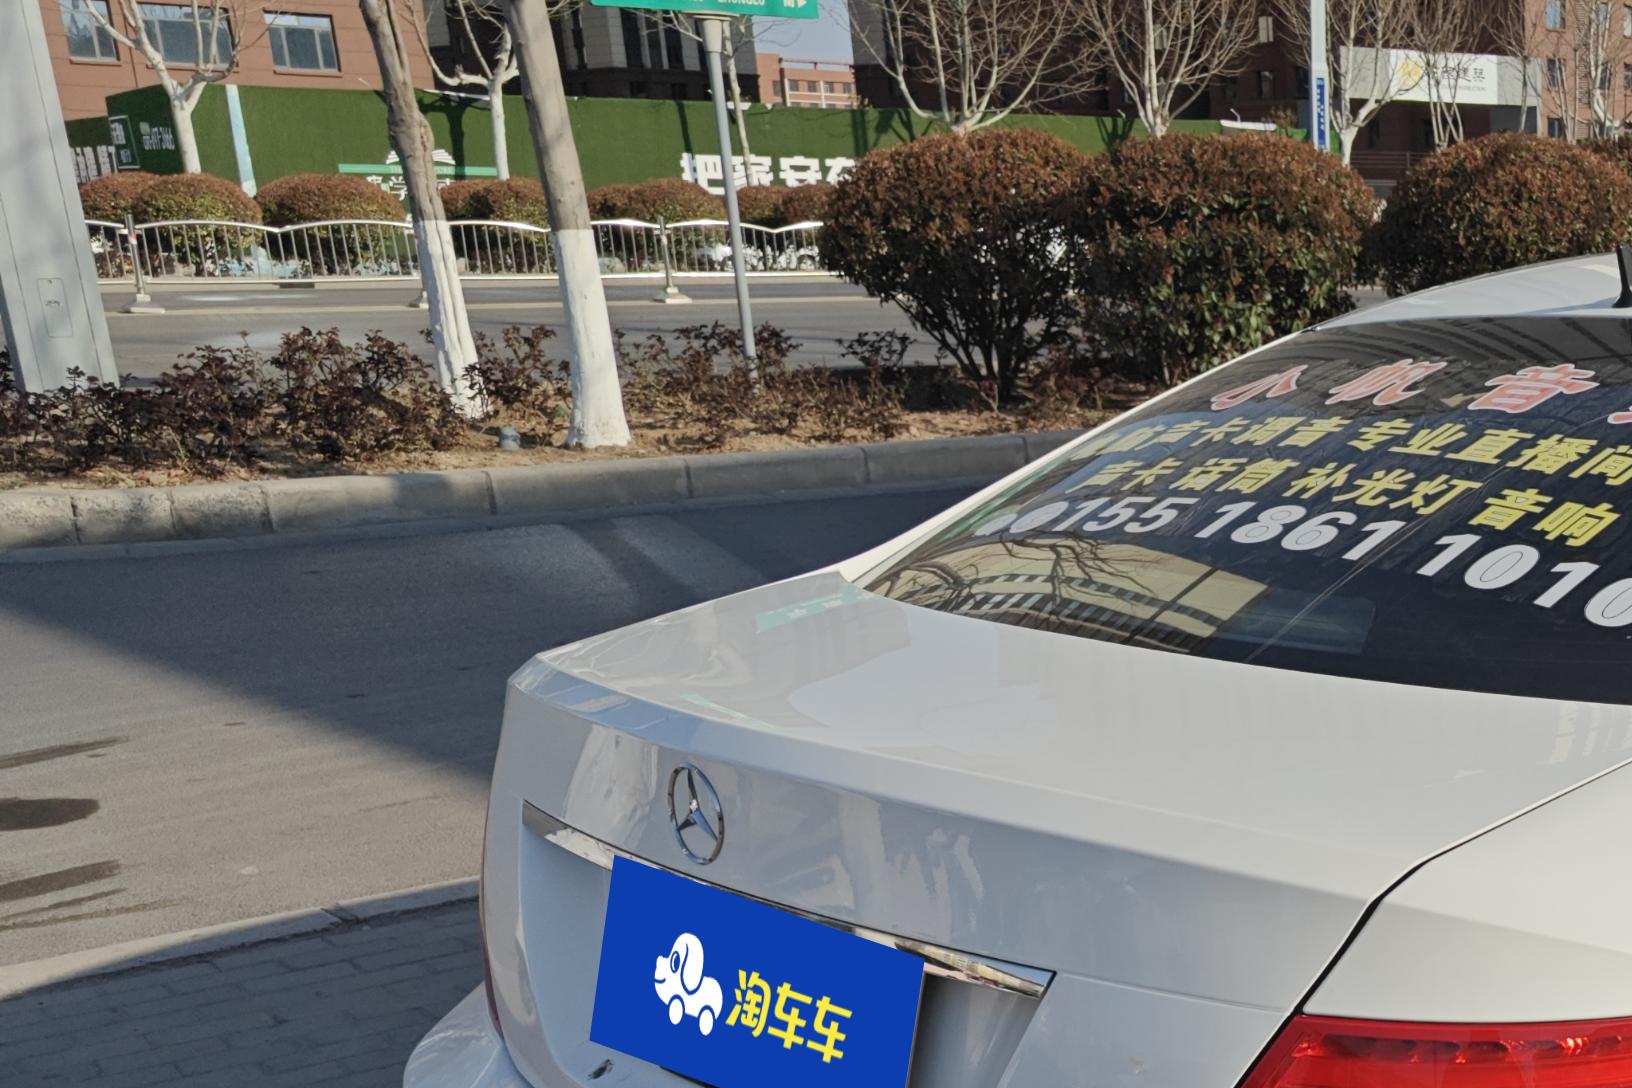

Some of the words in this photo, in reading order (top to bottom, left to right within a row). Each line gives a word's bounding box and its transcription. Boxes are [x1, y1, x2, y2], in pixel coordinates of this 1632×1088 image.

[1065, 457, 1300, 494] 声卡话筒
[1282, 462, 1483, 515] 补光灯
[1468, 488, 1621, 547] 音响
[1194, 501, 1407, 560] 1861
